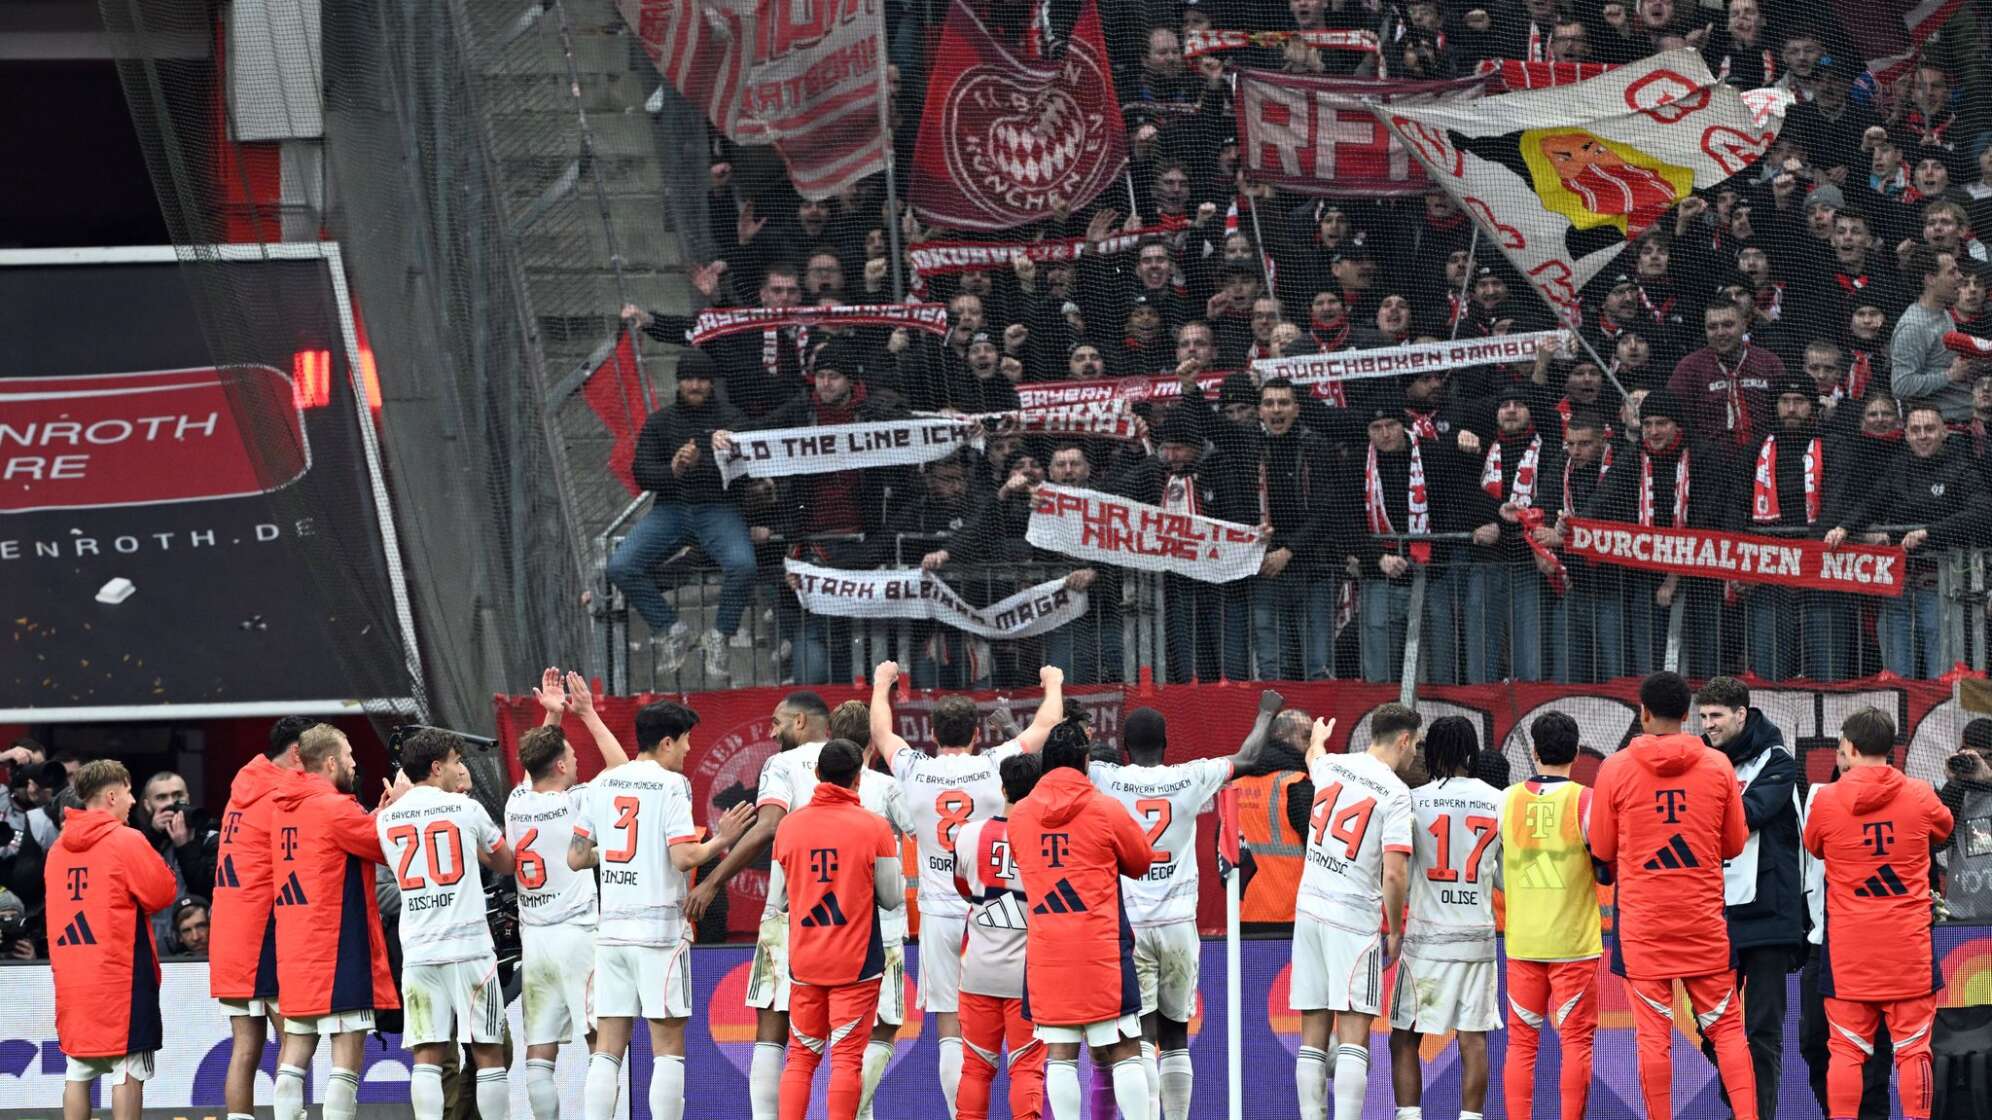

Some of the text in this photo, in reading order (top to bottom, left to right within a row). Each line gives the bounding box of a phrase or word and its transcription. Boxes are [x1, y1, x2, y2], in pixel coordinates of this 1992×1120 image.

[1276, 339, 1537, 380] DURCHBOXEN RAMBO
[1572, 526, 1895, 585] DURCHHALTEN NICK
[926, 775, 956, 786] BAYERN
[1111, 778, 1192, 794] FC BAYERN MÜNCHEN
[1420, 799, 1430, 808] FC
[1434, 798, 1466, 809] BAYERN
[391, 809, 421, 821] BAYERN
[423, 804, 462, 817] MÜNCHEN
[605, 796, 640, 864] 3
[936, 789, 974, 853] 8
[1136, 798, 1172, 864] 2
[1310, 780, 1377, 862] 44
[387, 820, 465, 892] 20
[514, 827, 548, 891] 6
[1427, 814, 1498, 884] 17
[408, 892, 455, 912] BISCHOF
[1441, 889, 1478, 905] OLISE
